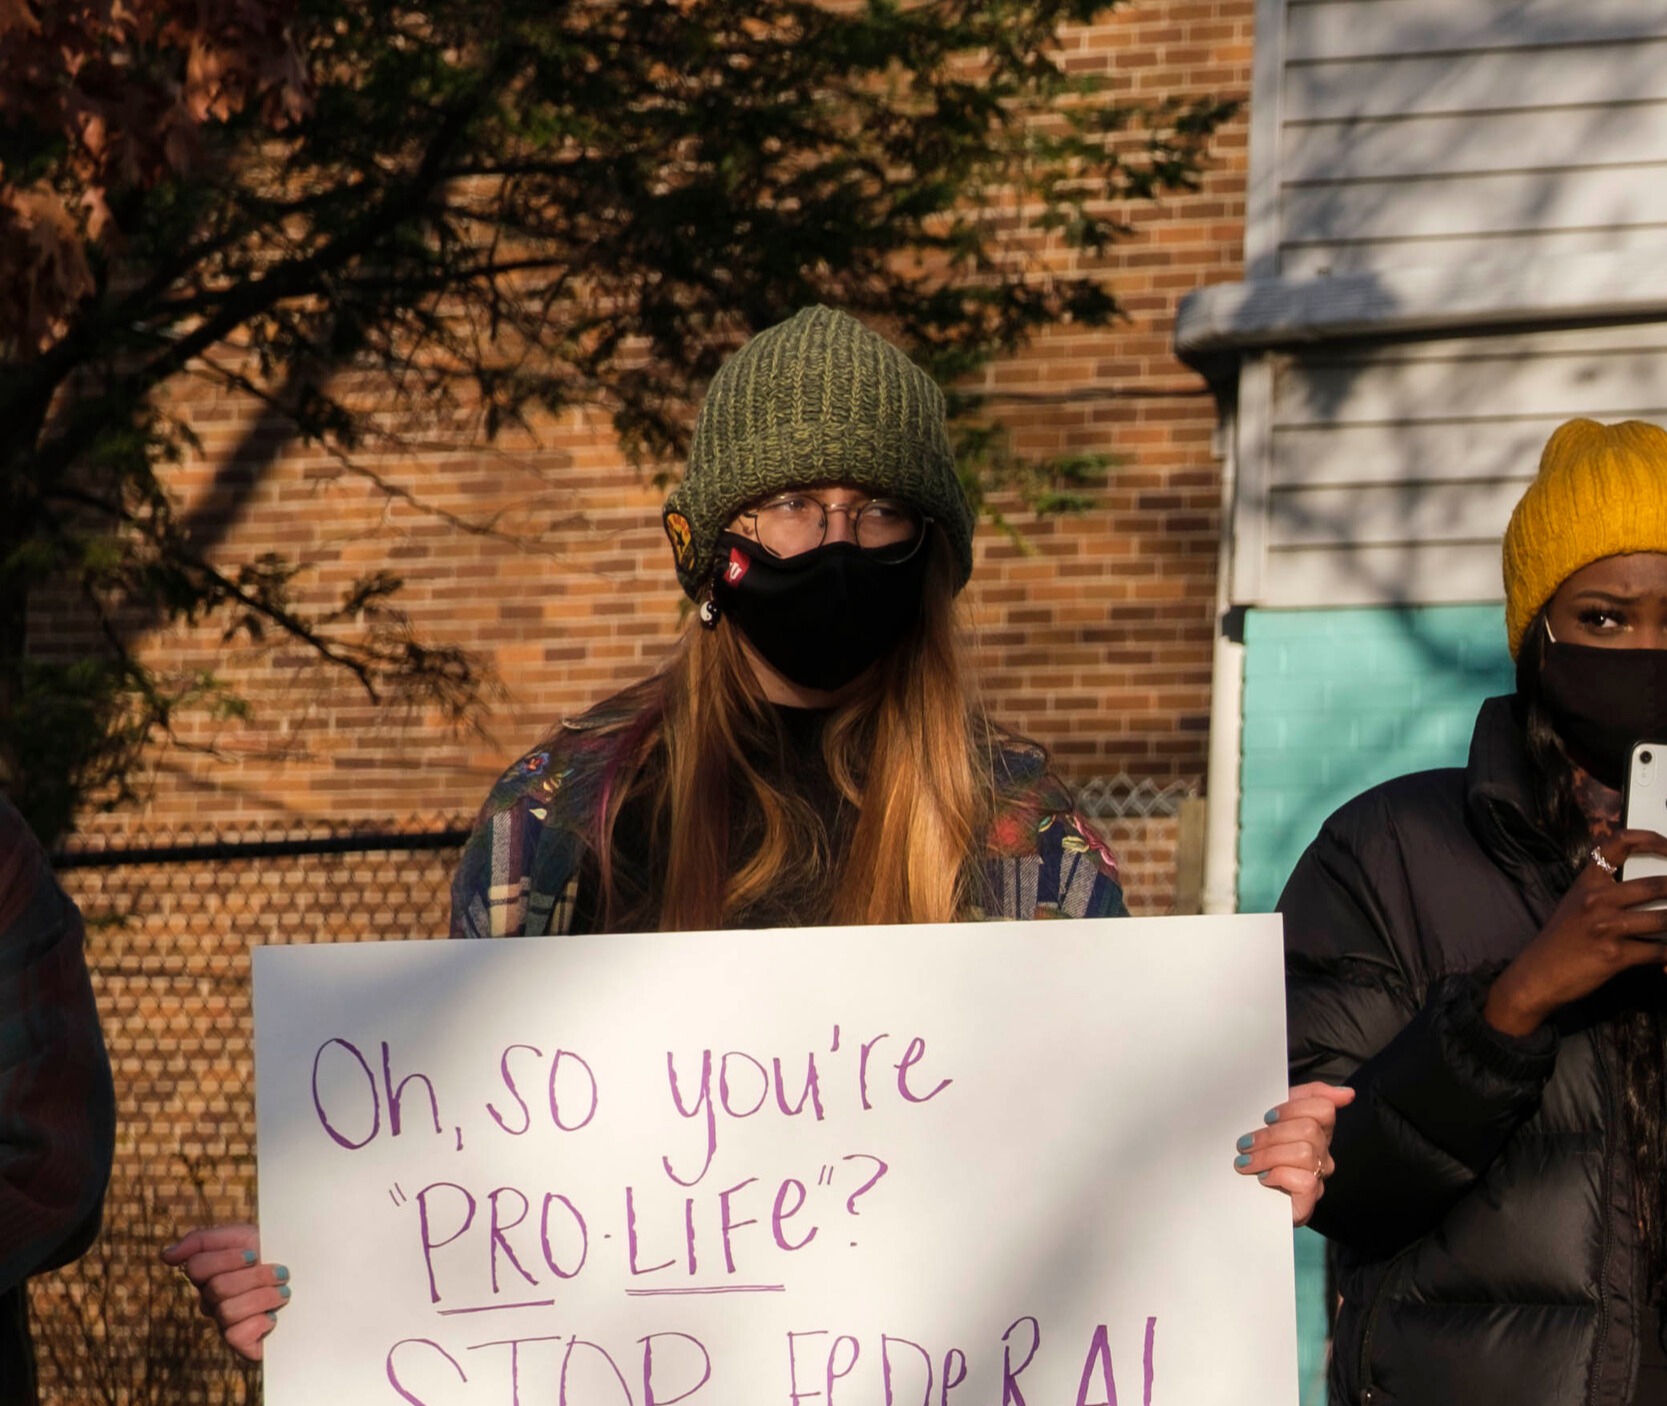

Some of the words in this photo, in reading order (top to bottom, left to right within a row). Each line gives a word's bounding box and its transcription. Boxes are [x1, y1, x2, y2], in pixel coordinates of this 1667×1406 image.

[312, 1037, 466, 1150] Oh,
[487, 1043, 598, 1136] so
[662, 1025, 953, 1187] you're
